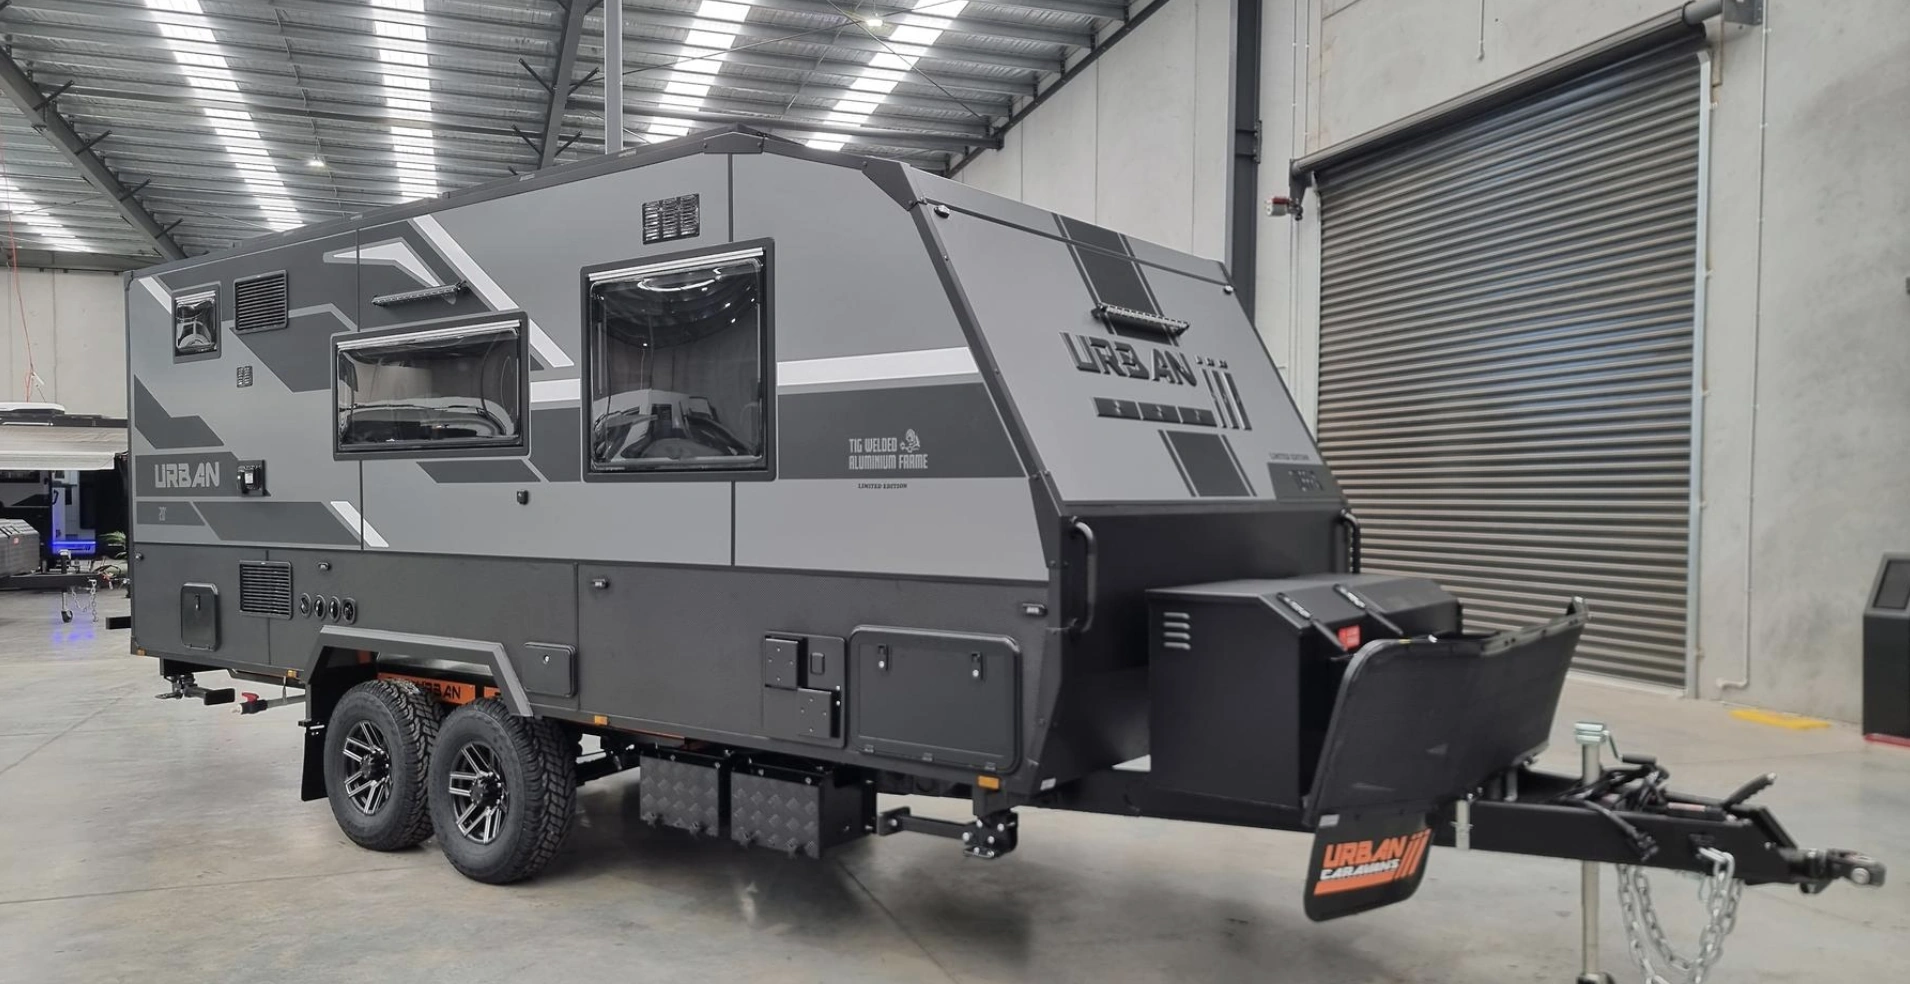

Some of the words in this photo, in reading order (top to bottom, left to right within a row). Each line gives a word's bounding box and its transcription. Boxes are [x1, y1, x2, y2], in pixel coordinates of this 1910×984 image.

[1059, 332, 1197, 387] URBAN
[848, 438, 862, 453] TIG
[864, 437, 898, 452] WELDED
[848, 454, 897, 469] ALUMINIUM
[154, 461, 220, 488] URBAN
[1323, 835, 1408, 869] URBAN
[1320, 858, 1400, 880] CARAVANS
